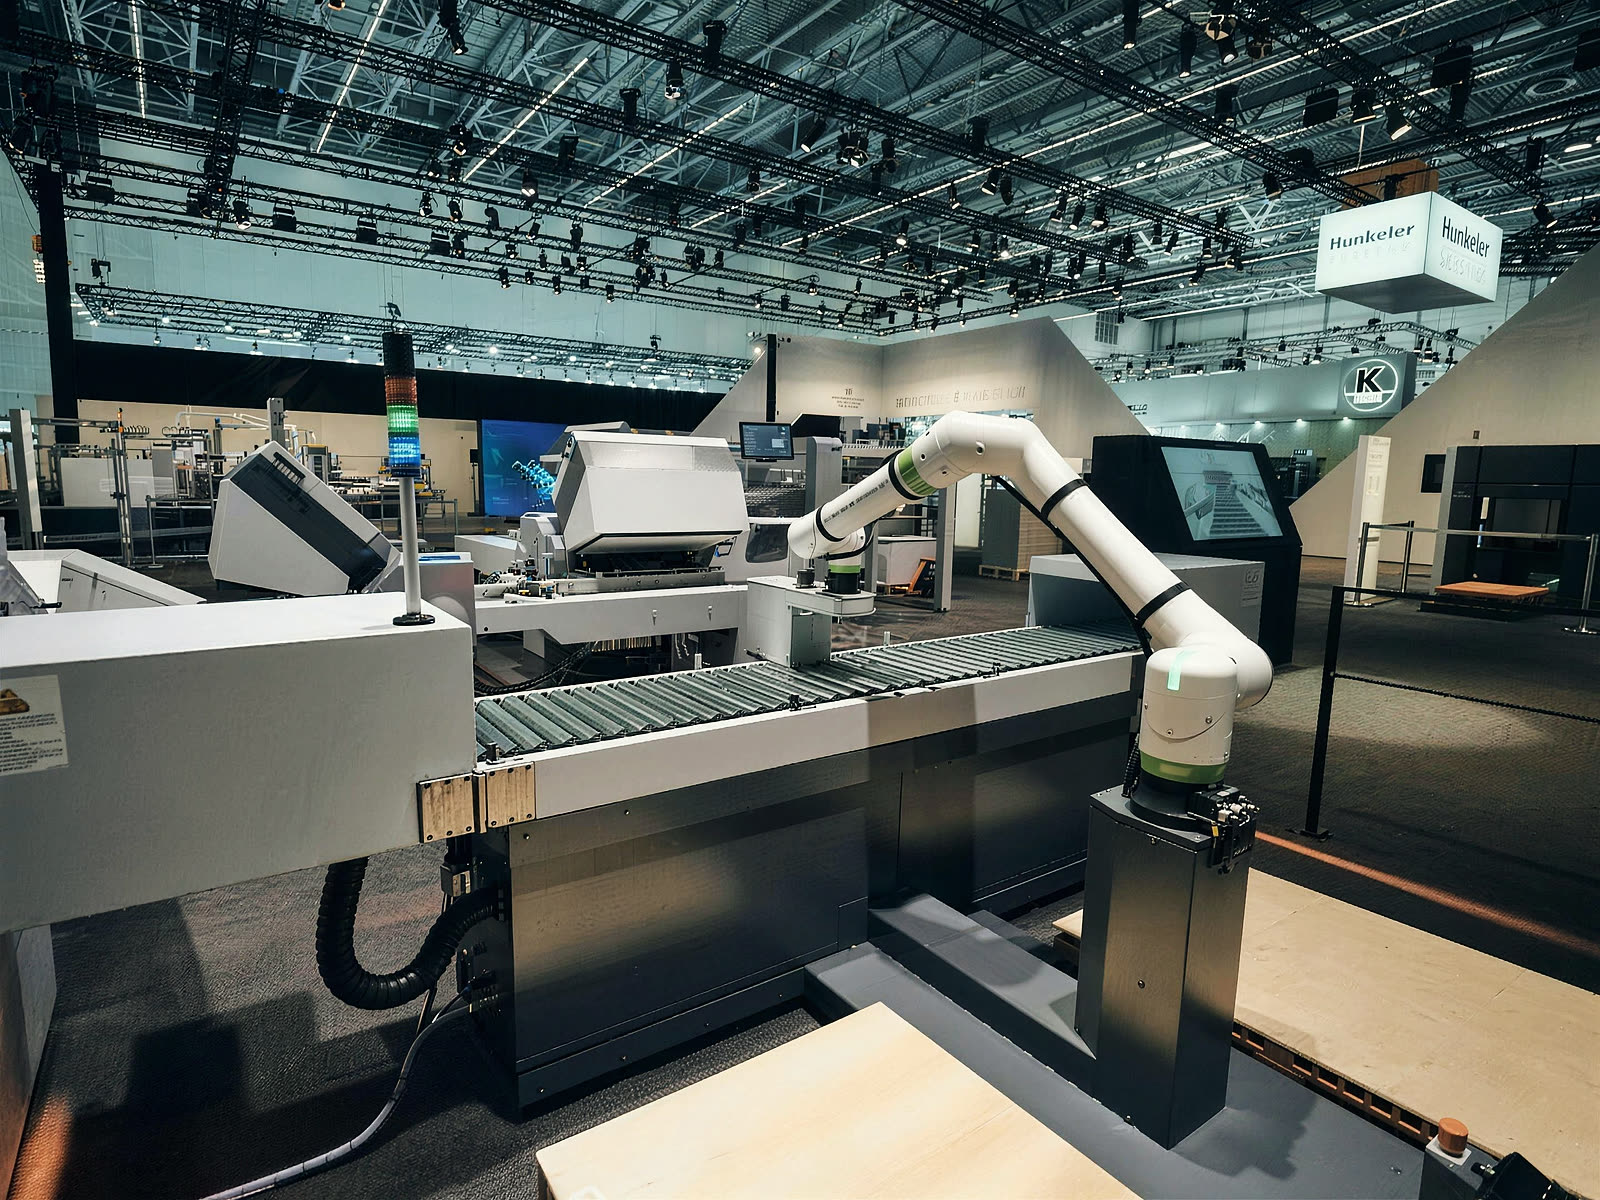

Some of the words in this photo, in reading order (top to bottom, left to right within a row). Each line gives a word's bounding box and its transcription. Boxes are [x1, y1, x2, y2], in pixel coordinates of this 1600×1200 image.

[1329, 224, 1415, 250] Hunkeler
[1442, 215, 1490, 258] Hunkeler
[1356, 366, 1386, 393] K
